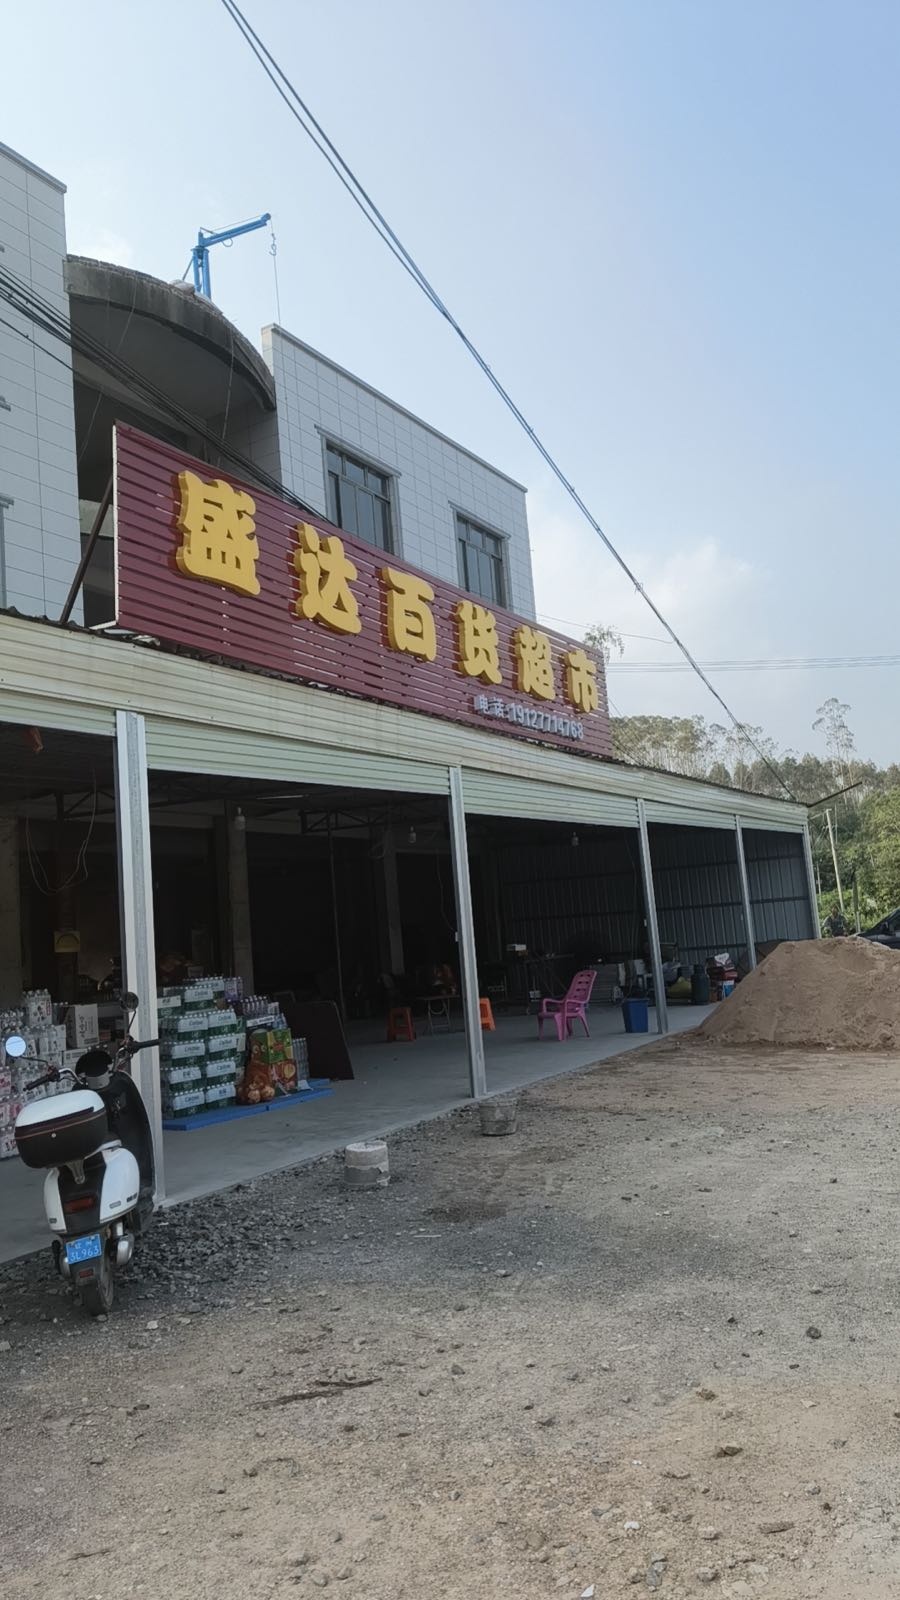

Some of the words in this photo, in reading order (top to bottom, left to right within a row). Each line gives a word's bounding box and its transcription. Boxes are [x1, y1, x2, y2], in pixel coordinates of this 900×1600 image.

[176, 470, 598, 713] 盛达百货超市
